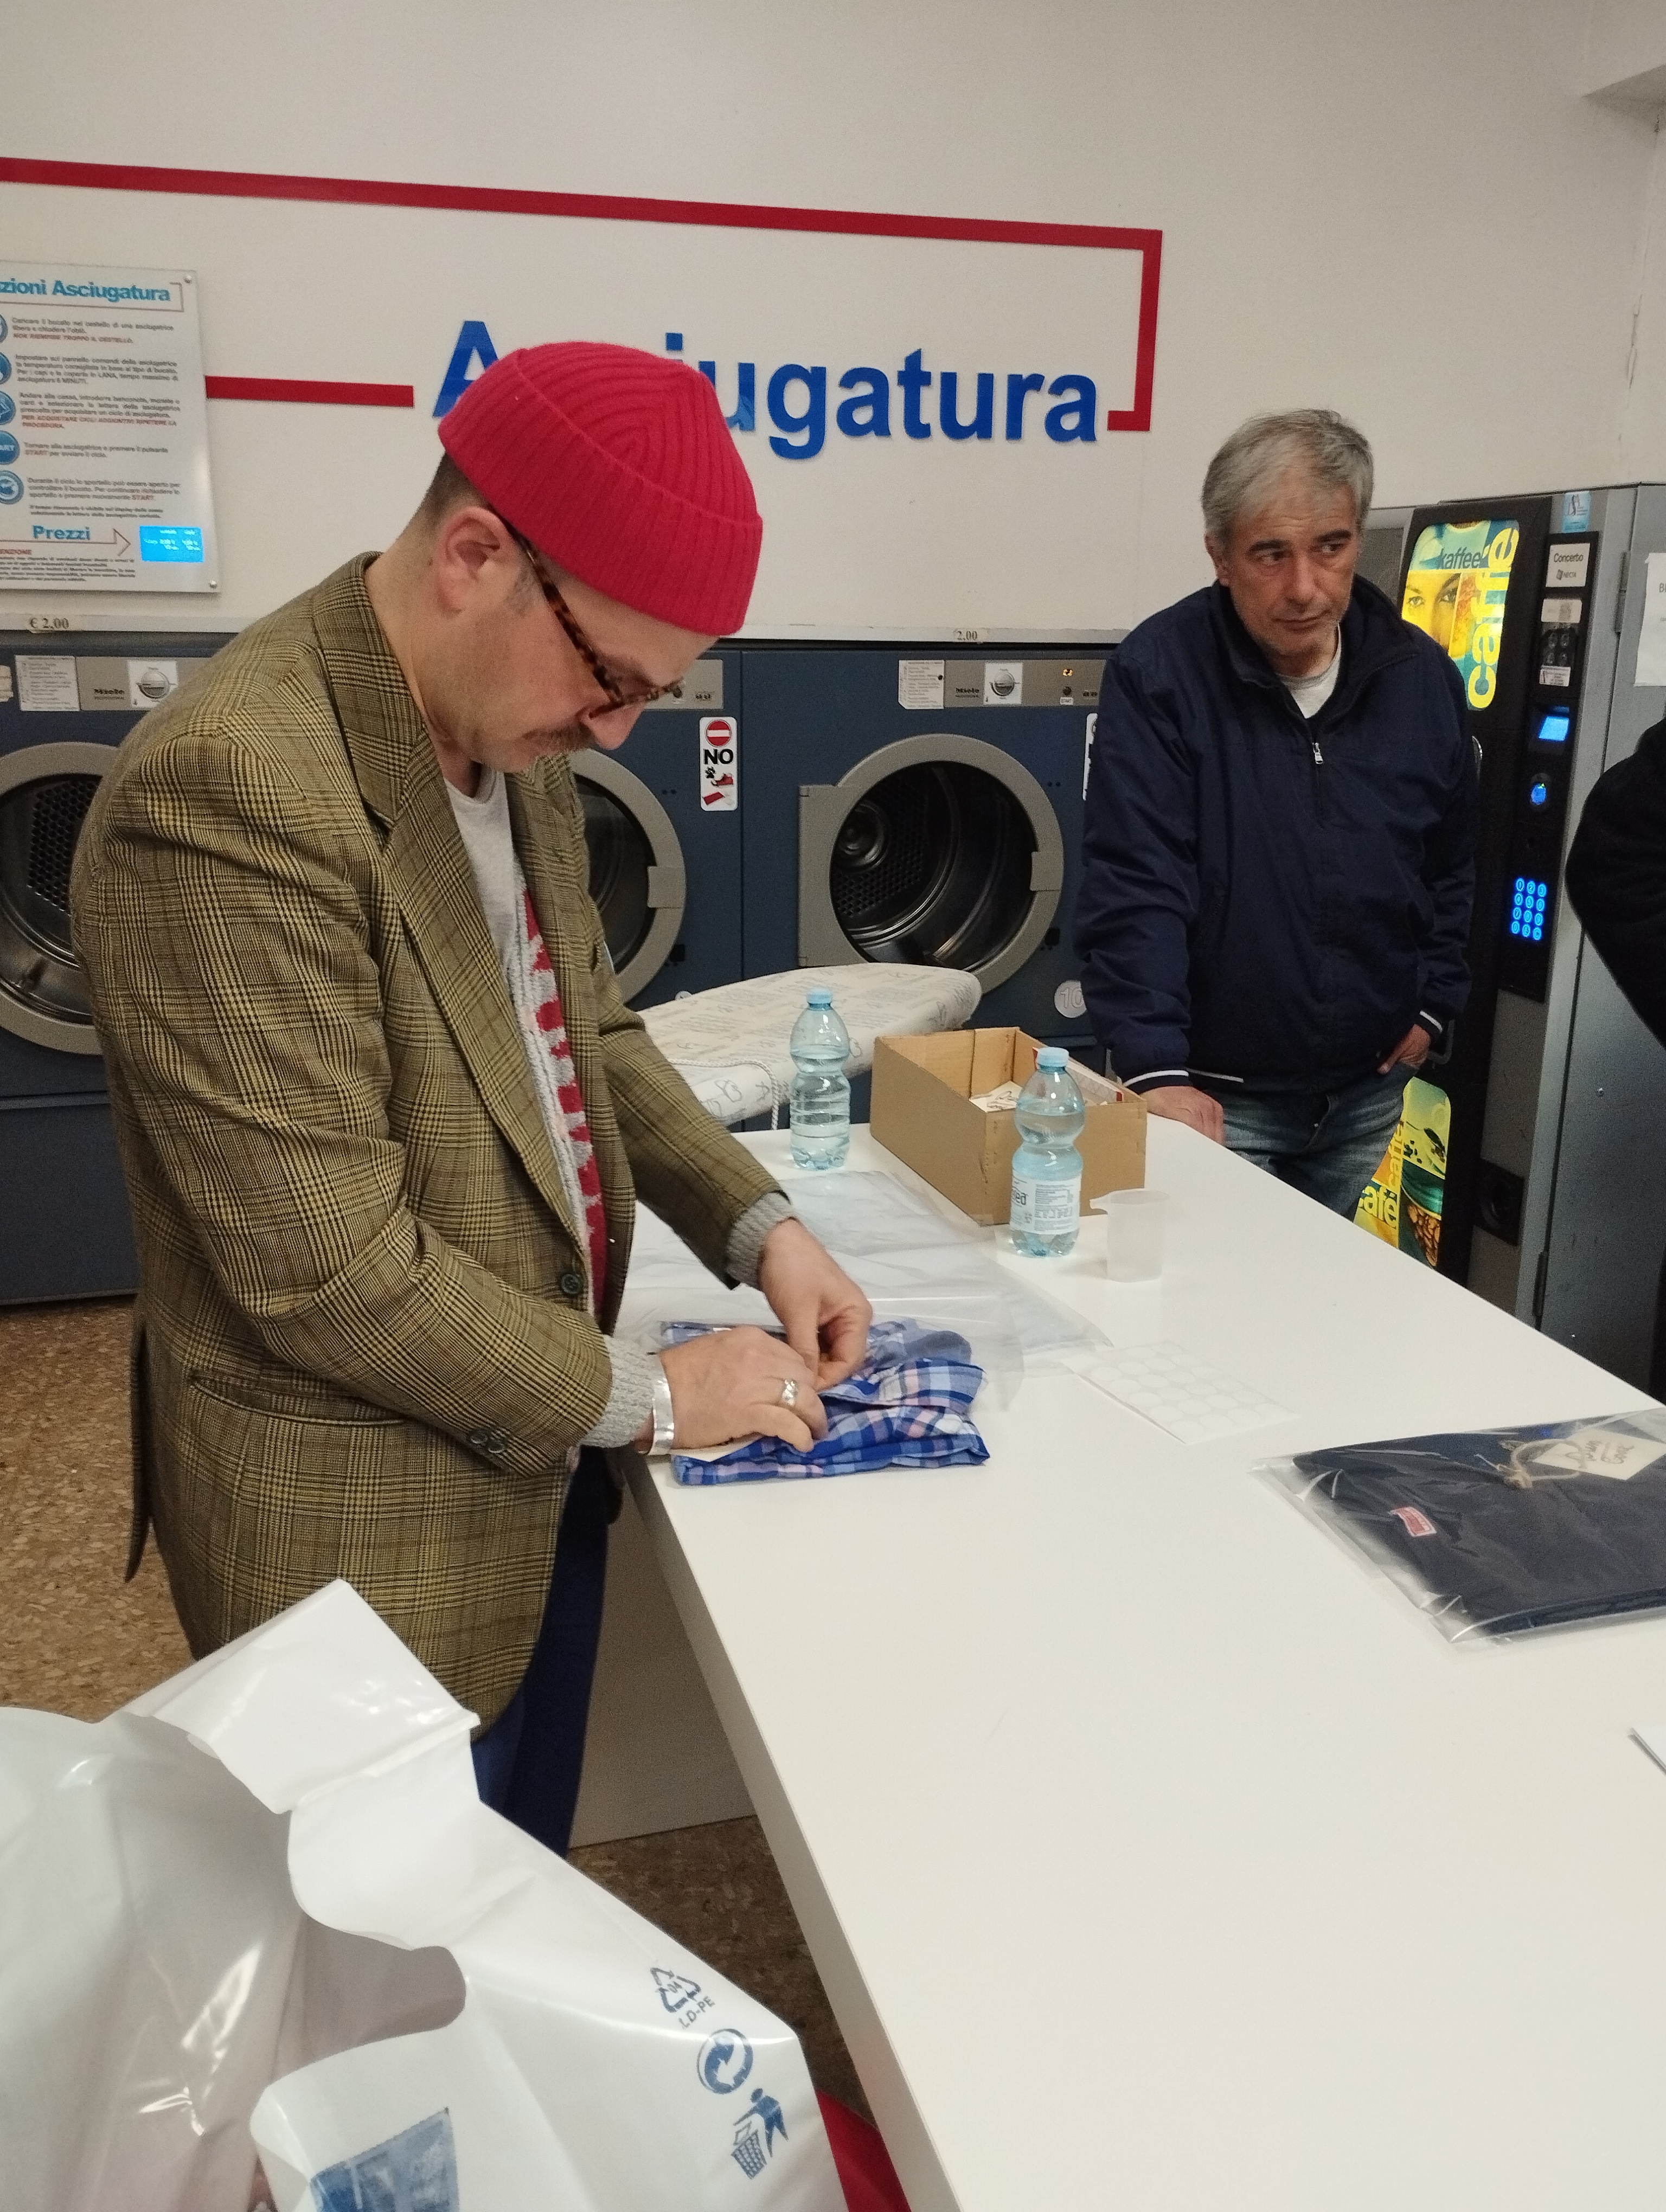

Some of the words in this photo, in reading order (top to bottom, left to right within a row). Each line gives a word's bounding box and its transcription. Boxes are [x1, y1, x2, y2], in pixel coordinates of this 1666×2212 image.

[53, 280, 170, 302] Asciugatura
[33, 524, 91, 540] Prezzi
[1439, 546, 1481, 570] kaffee
[1553, 552, 1584, 563] Concerto
[29, 617, 38, 628] €
[703, 749, 734, 765] NO
[1060, 987, 1084, 1009] 10
[678, 1996, 716, 2030] LD-PE
